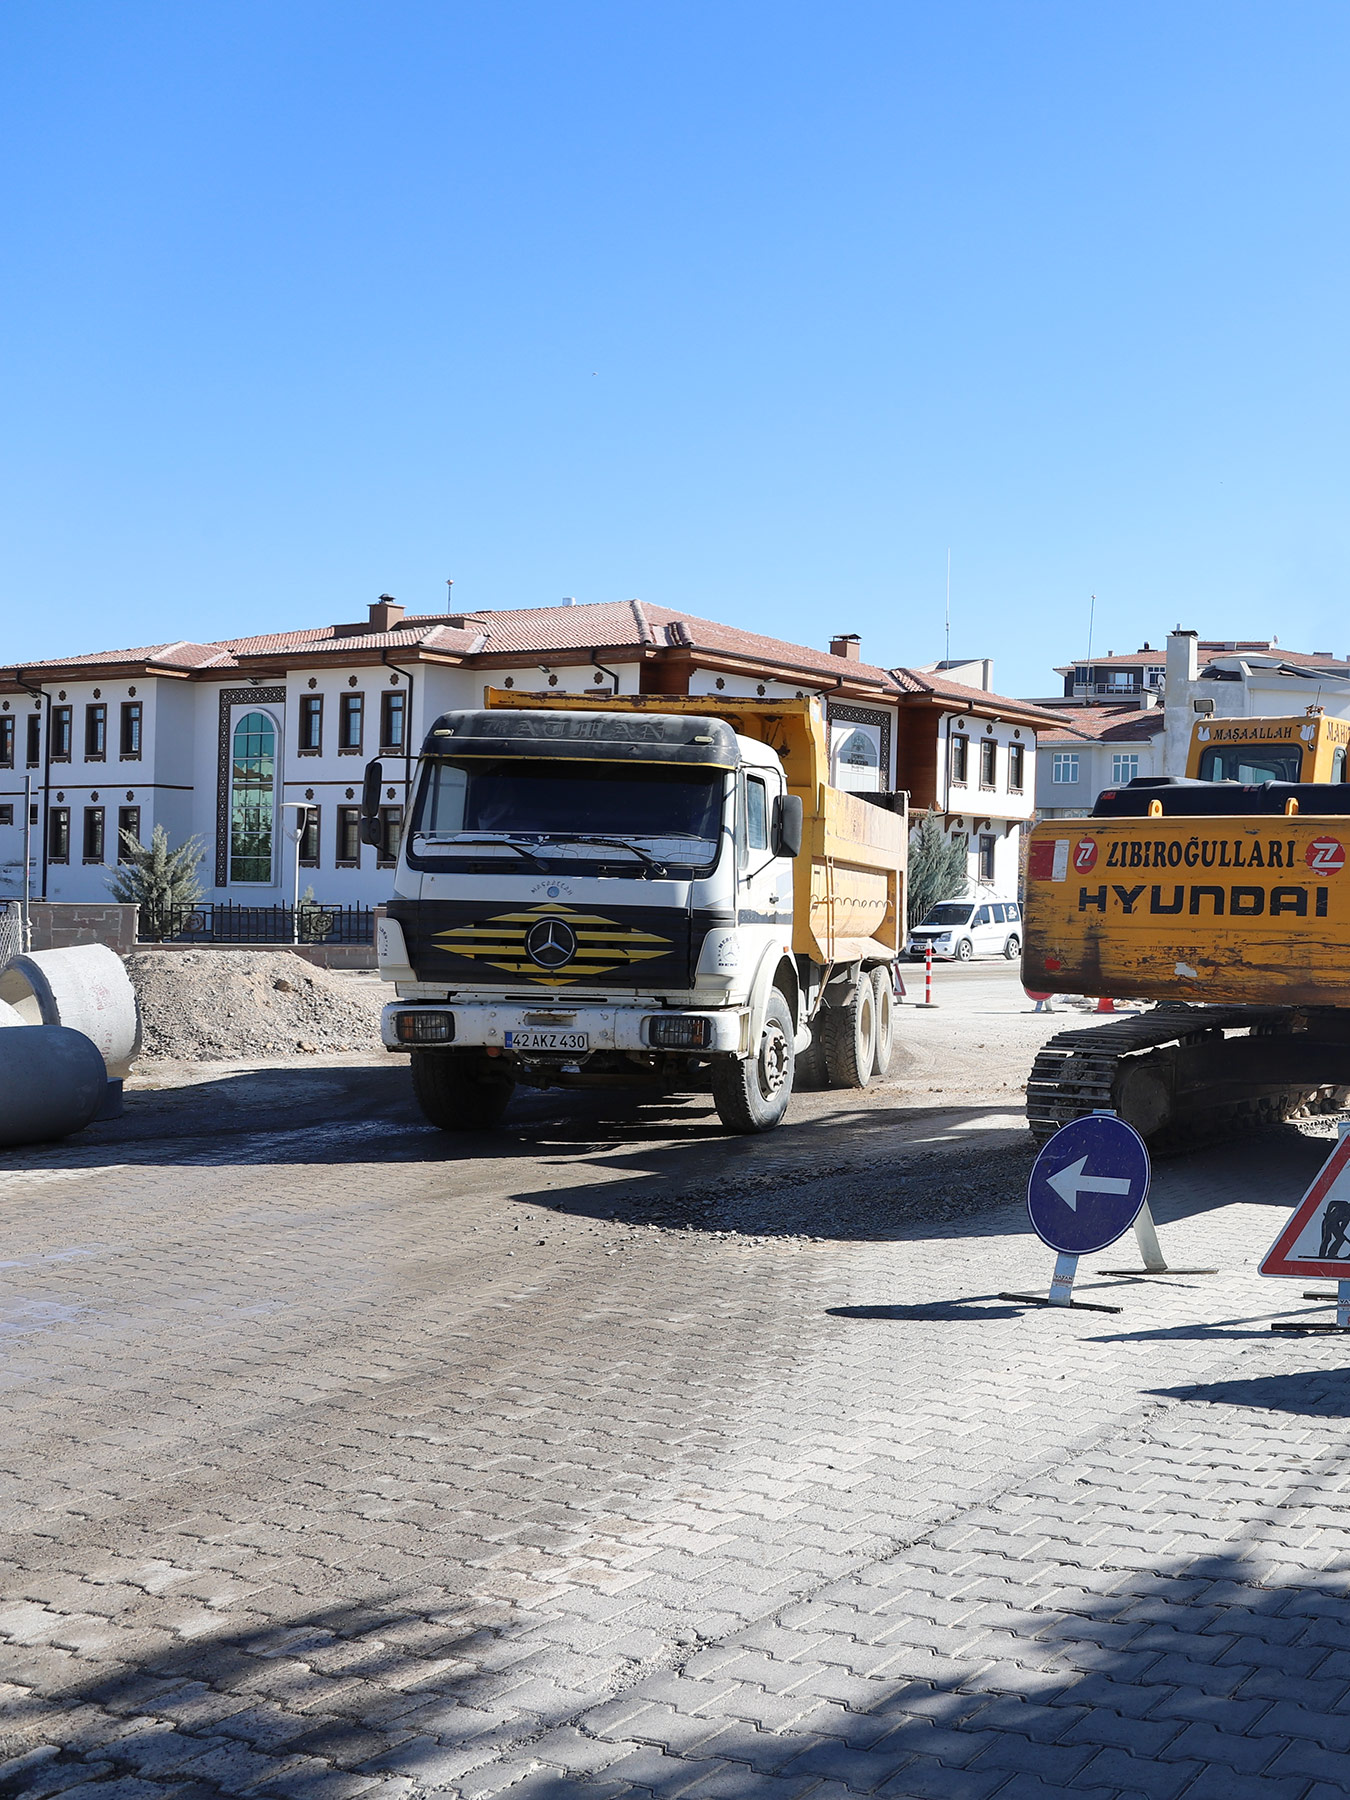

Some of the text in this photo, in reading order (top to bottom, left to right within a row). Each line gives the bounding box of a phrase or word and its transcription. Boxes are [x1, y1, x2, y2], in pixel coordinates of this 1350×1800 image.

[1213, 726, 1293, 742] MAŞAALLAH
[1078, 885, 1329, 917] HYUNDAI
[513, 1034, 585, 1048] 42 AKZ 430
